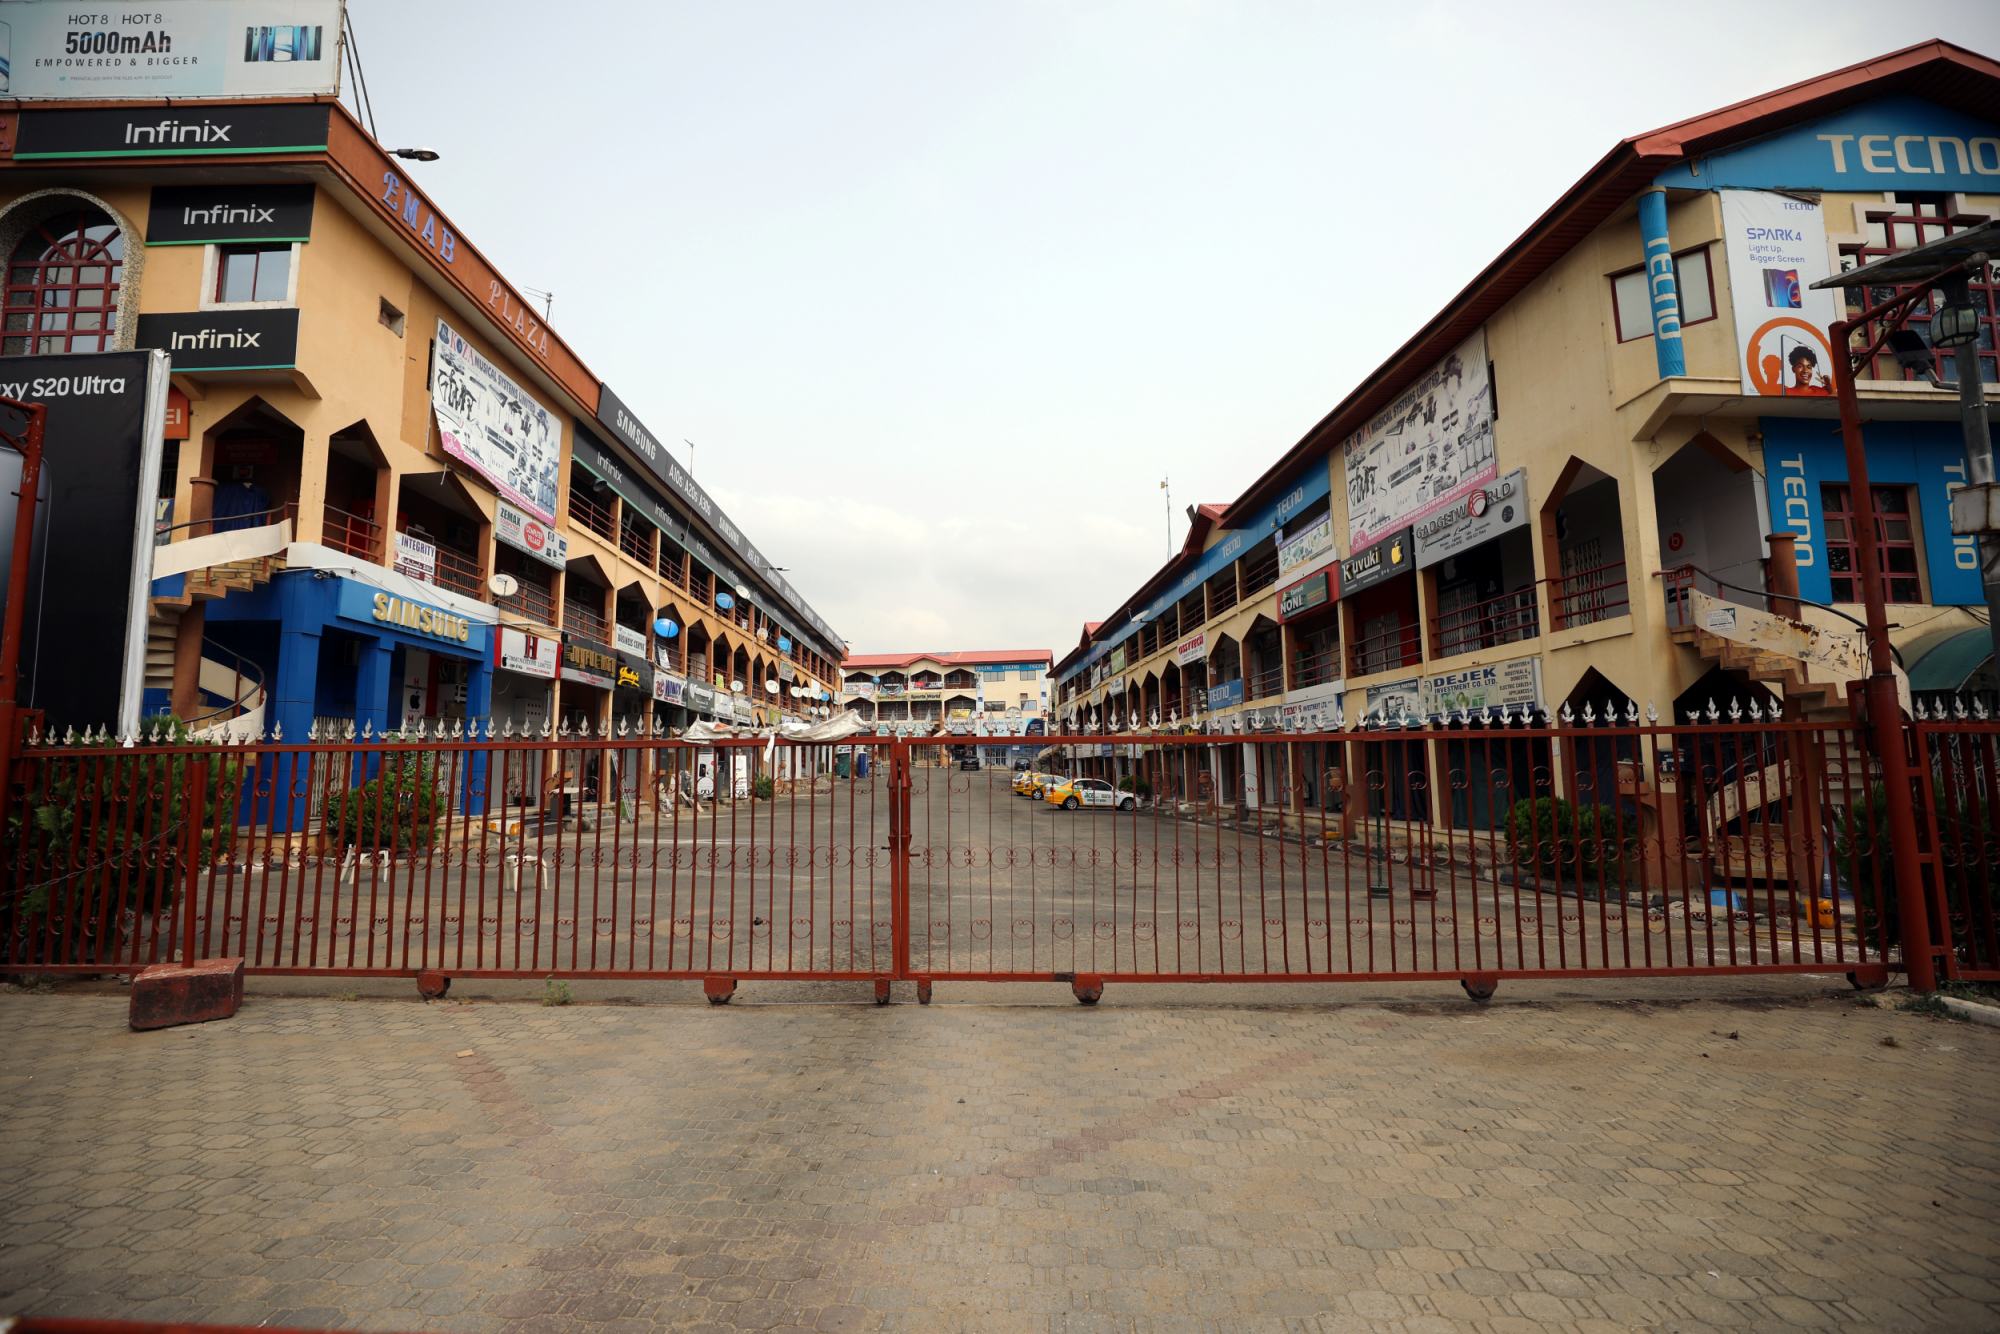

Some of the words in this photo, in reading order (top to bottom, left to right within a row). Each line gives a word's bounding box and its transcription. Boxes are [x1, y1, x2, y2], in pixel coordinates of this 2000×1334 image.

[68, 14, 98, 25] HOT
[100, 14, 109, 25] 8
[121, 13, 152, 25] HOT
[154, 13, 162, 24] 8
[65, 30, 172, 55] 5000mAh
[35, 57, 122, 68] EMPOWERED
[130, 57, 137, 67] &
[147, 56, 199, 67] BIGGER
[125, 119, 232, 144] Infinix
[1816, 133, 2000, 175] TECNO
[183, 203, 275, 225] Infinix
[382, 171, 456, 264] EMAB
[1783, 202, 1814, 211] TECNO
[1746, 227, 1794, 241] SPARK
[1795, 231, 1802, 241] 4
[1748, 244, 1769, 253] Light
[1750, 253, 1776, 263] Bigger
[1777, 255, 1805, 263] Screen
[487, 279, 550, 359] PLAZA
[171, 327, 262, 350] Infinix
[31, 377, 70, 398] S20
[73, 375, 126, 396] Ultra
[615, 408, 657, 462] SAMSUNG
[596, 451, 623, 484] Infinix
[668, 463, 683, 488] A10s
[684, 479, 698, 504] A20s
[1276, 486, 1303, 515] TECNO
[1780, 452, 1815, 567] TECNO
[654, 502, 674, 528] Infinix
[401, 535, 435, 557] INTEGRITY
[1222, 535, 1241, 559] TECNO
[372, 592, 470, 643] SAMSUNG
[524, 634, 539, 660] H
[1433, 667, 1497, 688] DEJEK
[1434, 682, 1470, 694] INVESTMENT
[1208, 684, 1230, 705] TECNO
